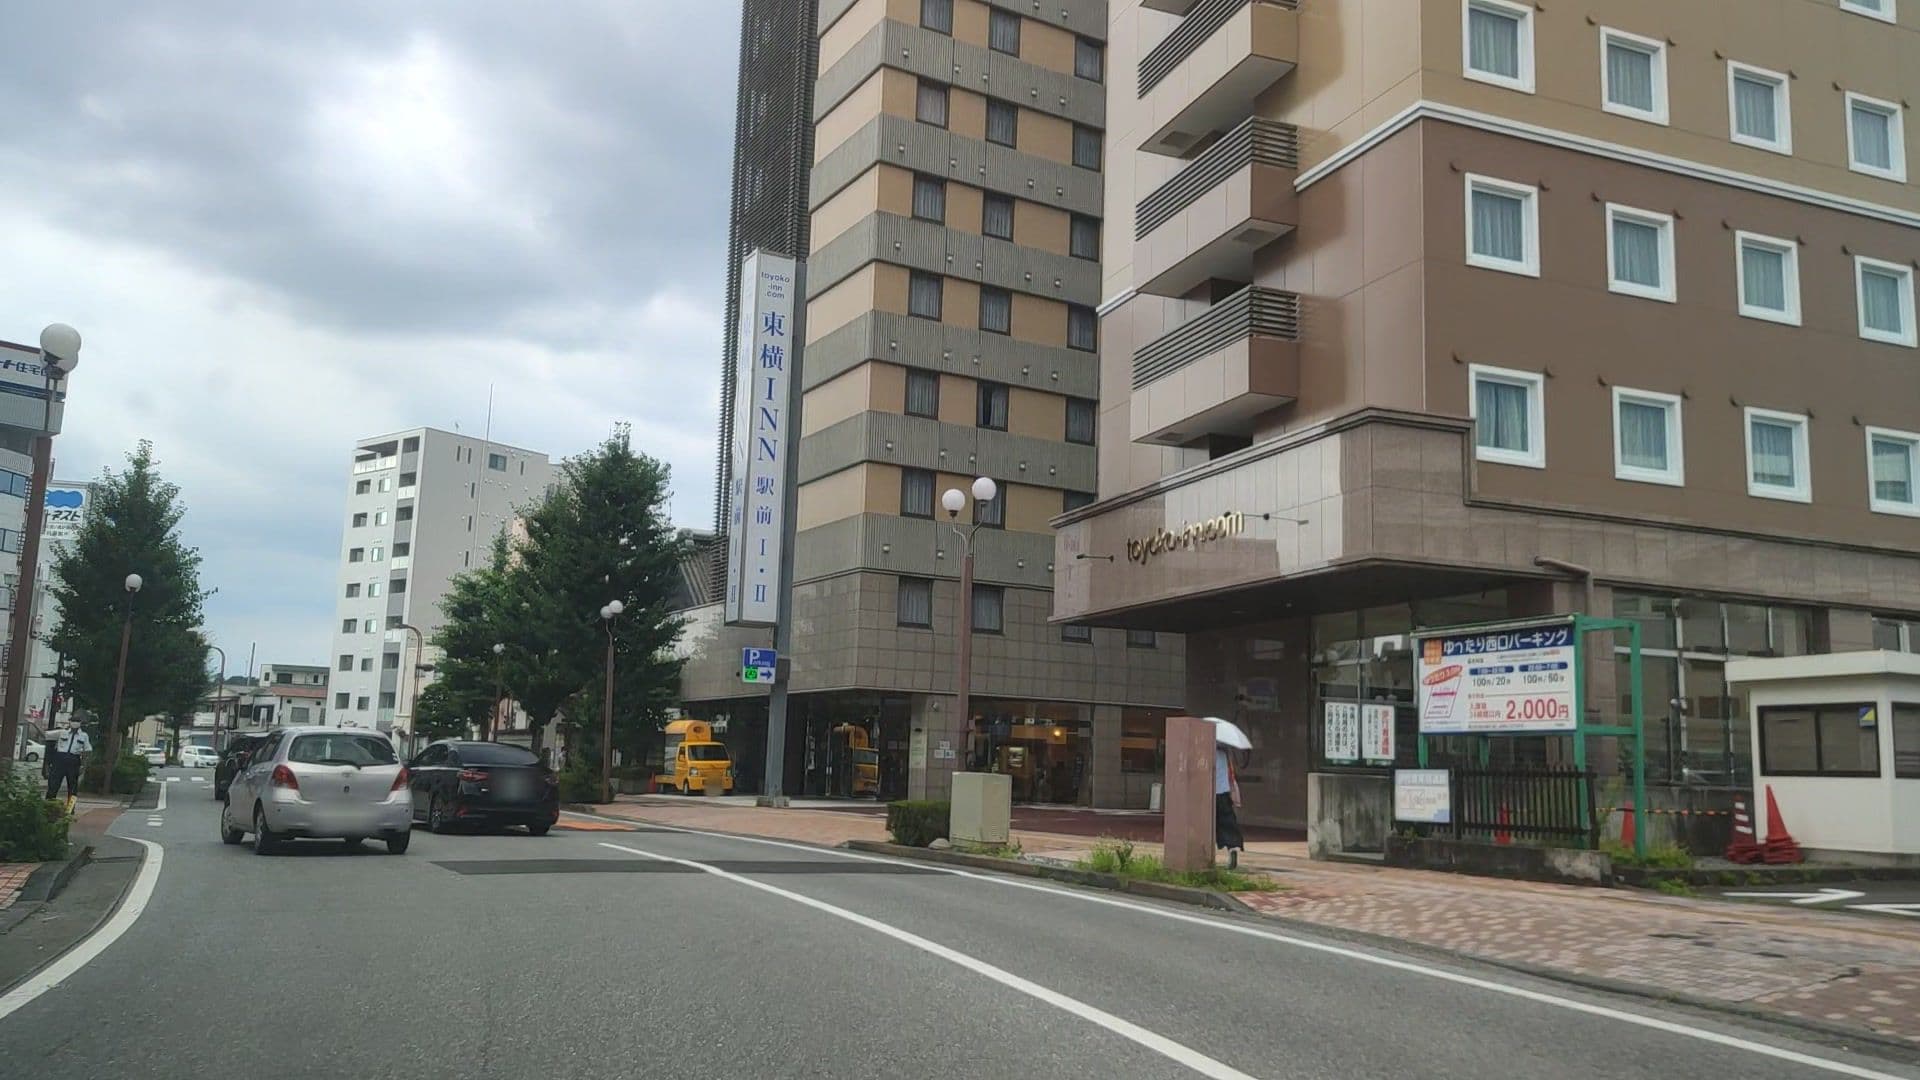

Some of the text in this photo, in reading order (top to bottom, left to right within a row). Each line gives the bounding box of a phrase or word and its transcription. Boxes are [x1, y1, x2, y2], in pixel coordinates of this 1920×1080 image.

[762, 272, 789, 281] toyoko
[1127, 511, 1244, 565] toyoko-inn.com
[1444, 628, 1568, 655] ゆったり西口パーキング
[1506, 698, 1568, 719] 2,000円
